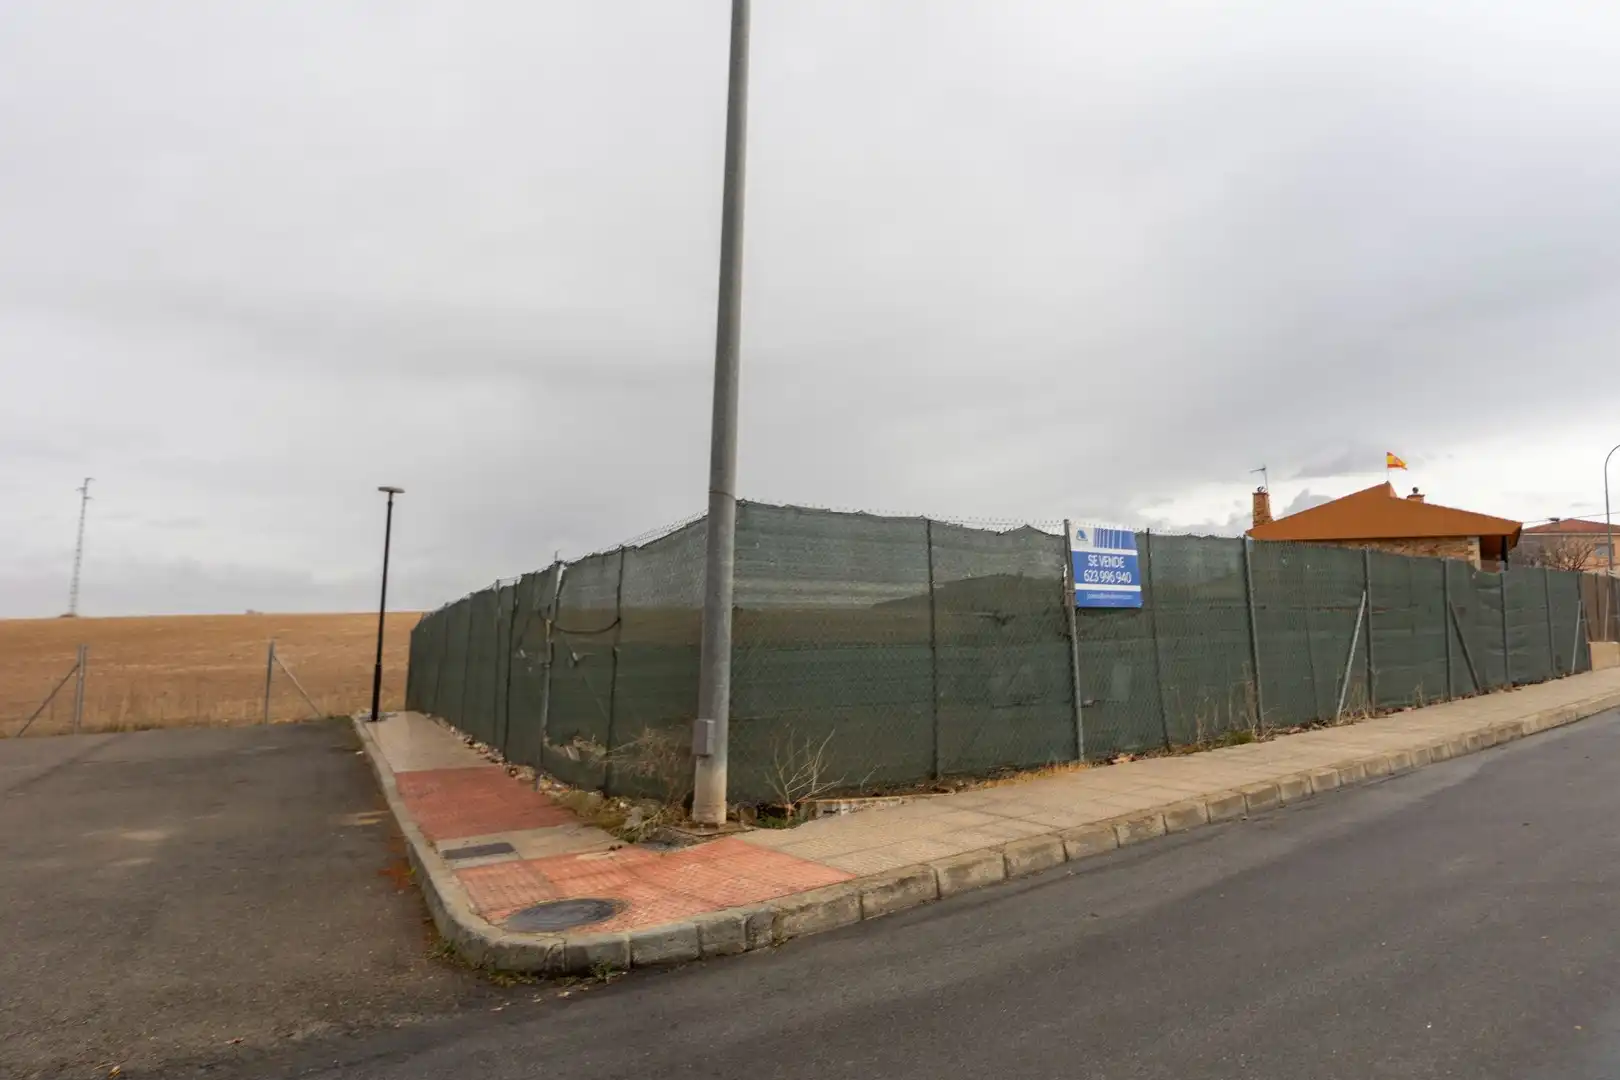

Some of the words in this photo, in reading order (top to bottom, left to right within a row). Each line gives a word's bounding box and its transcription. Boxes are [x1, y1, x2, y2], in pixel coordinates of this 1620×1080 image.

[1088, 554, 1098, 567] SE
[1099, 555, 1125, 568] VENDE
[1084, 569, 1099, 582] 623
[1116, 571, 1132, 584] 940
